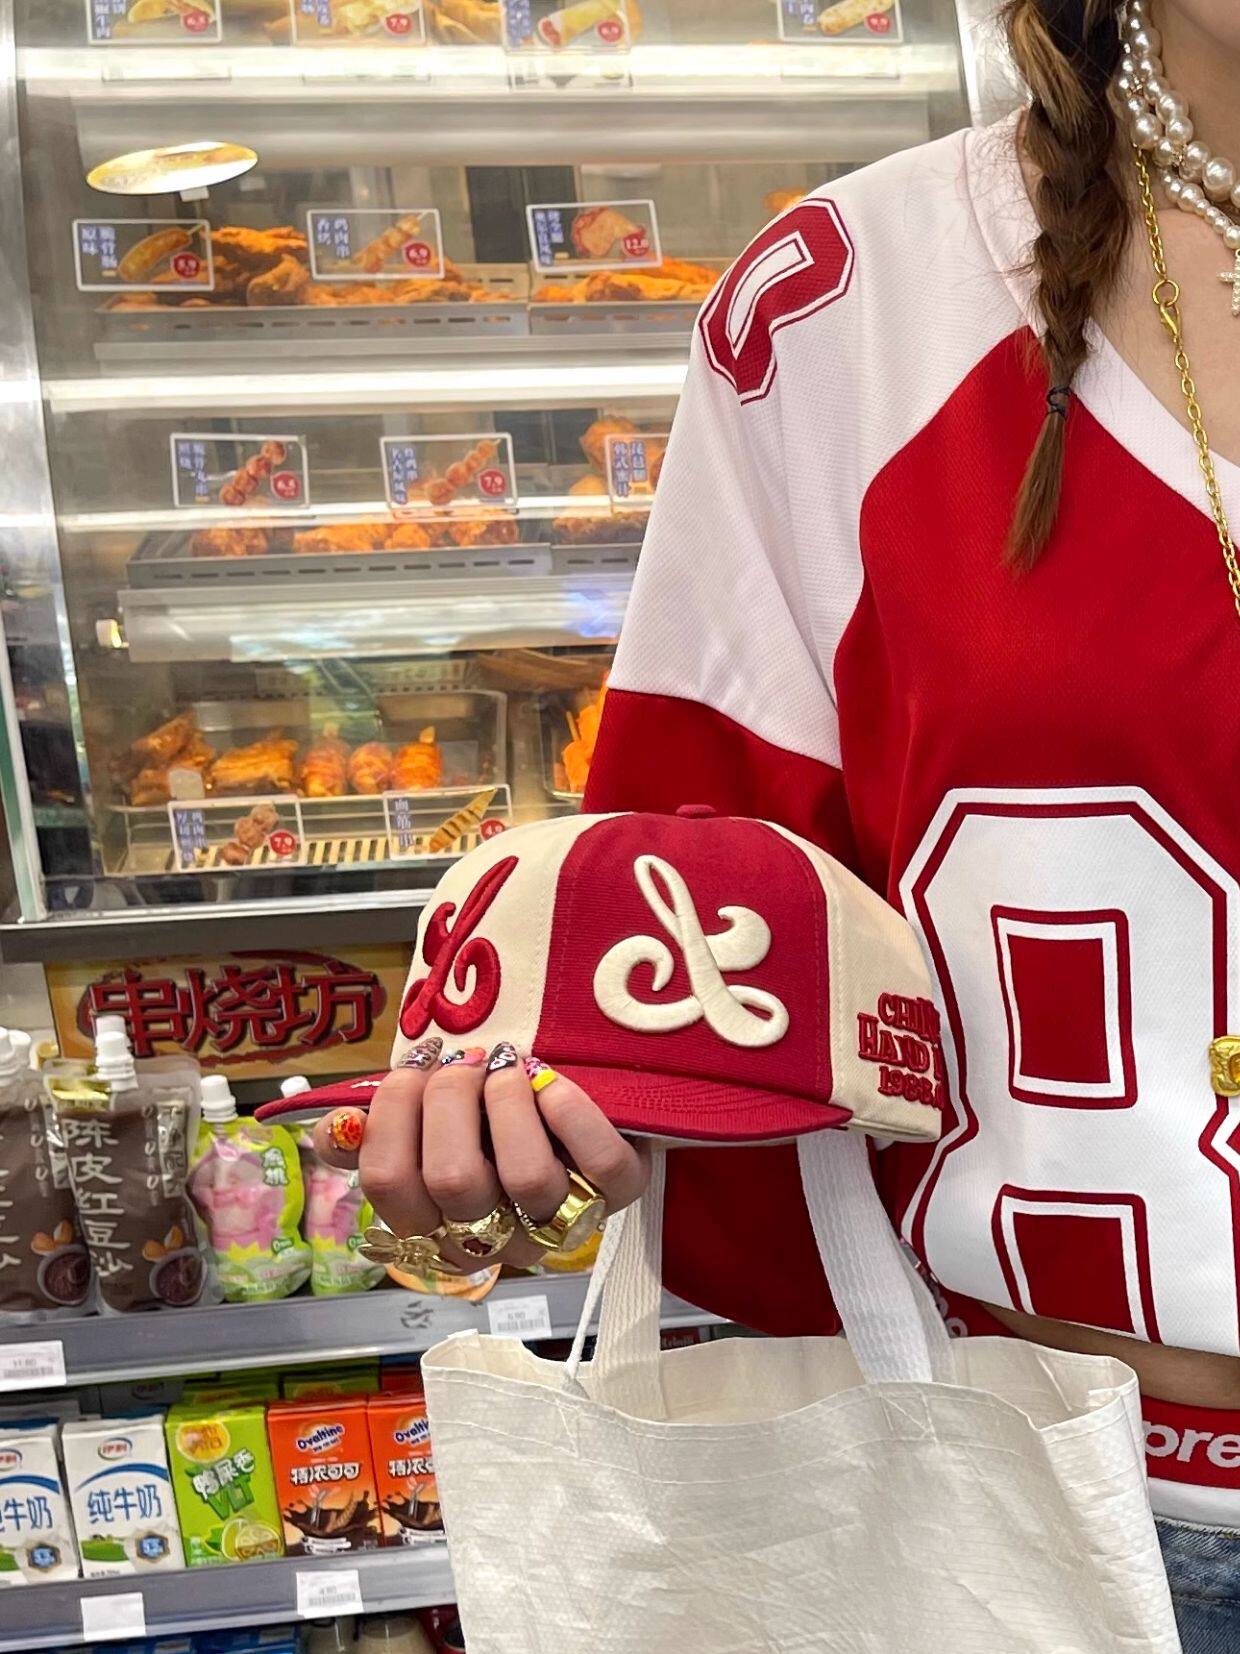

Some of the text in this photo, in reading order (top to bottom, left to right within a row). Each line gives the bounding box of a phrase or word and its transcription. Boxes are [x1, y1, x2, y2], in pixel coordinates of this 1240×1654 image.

[297, 1424, 345, 1451] Ovaltine
[86, 1482, 165, 1527] 纯牛奶
